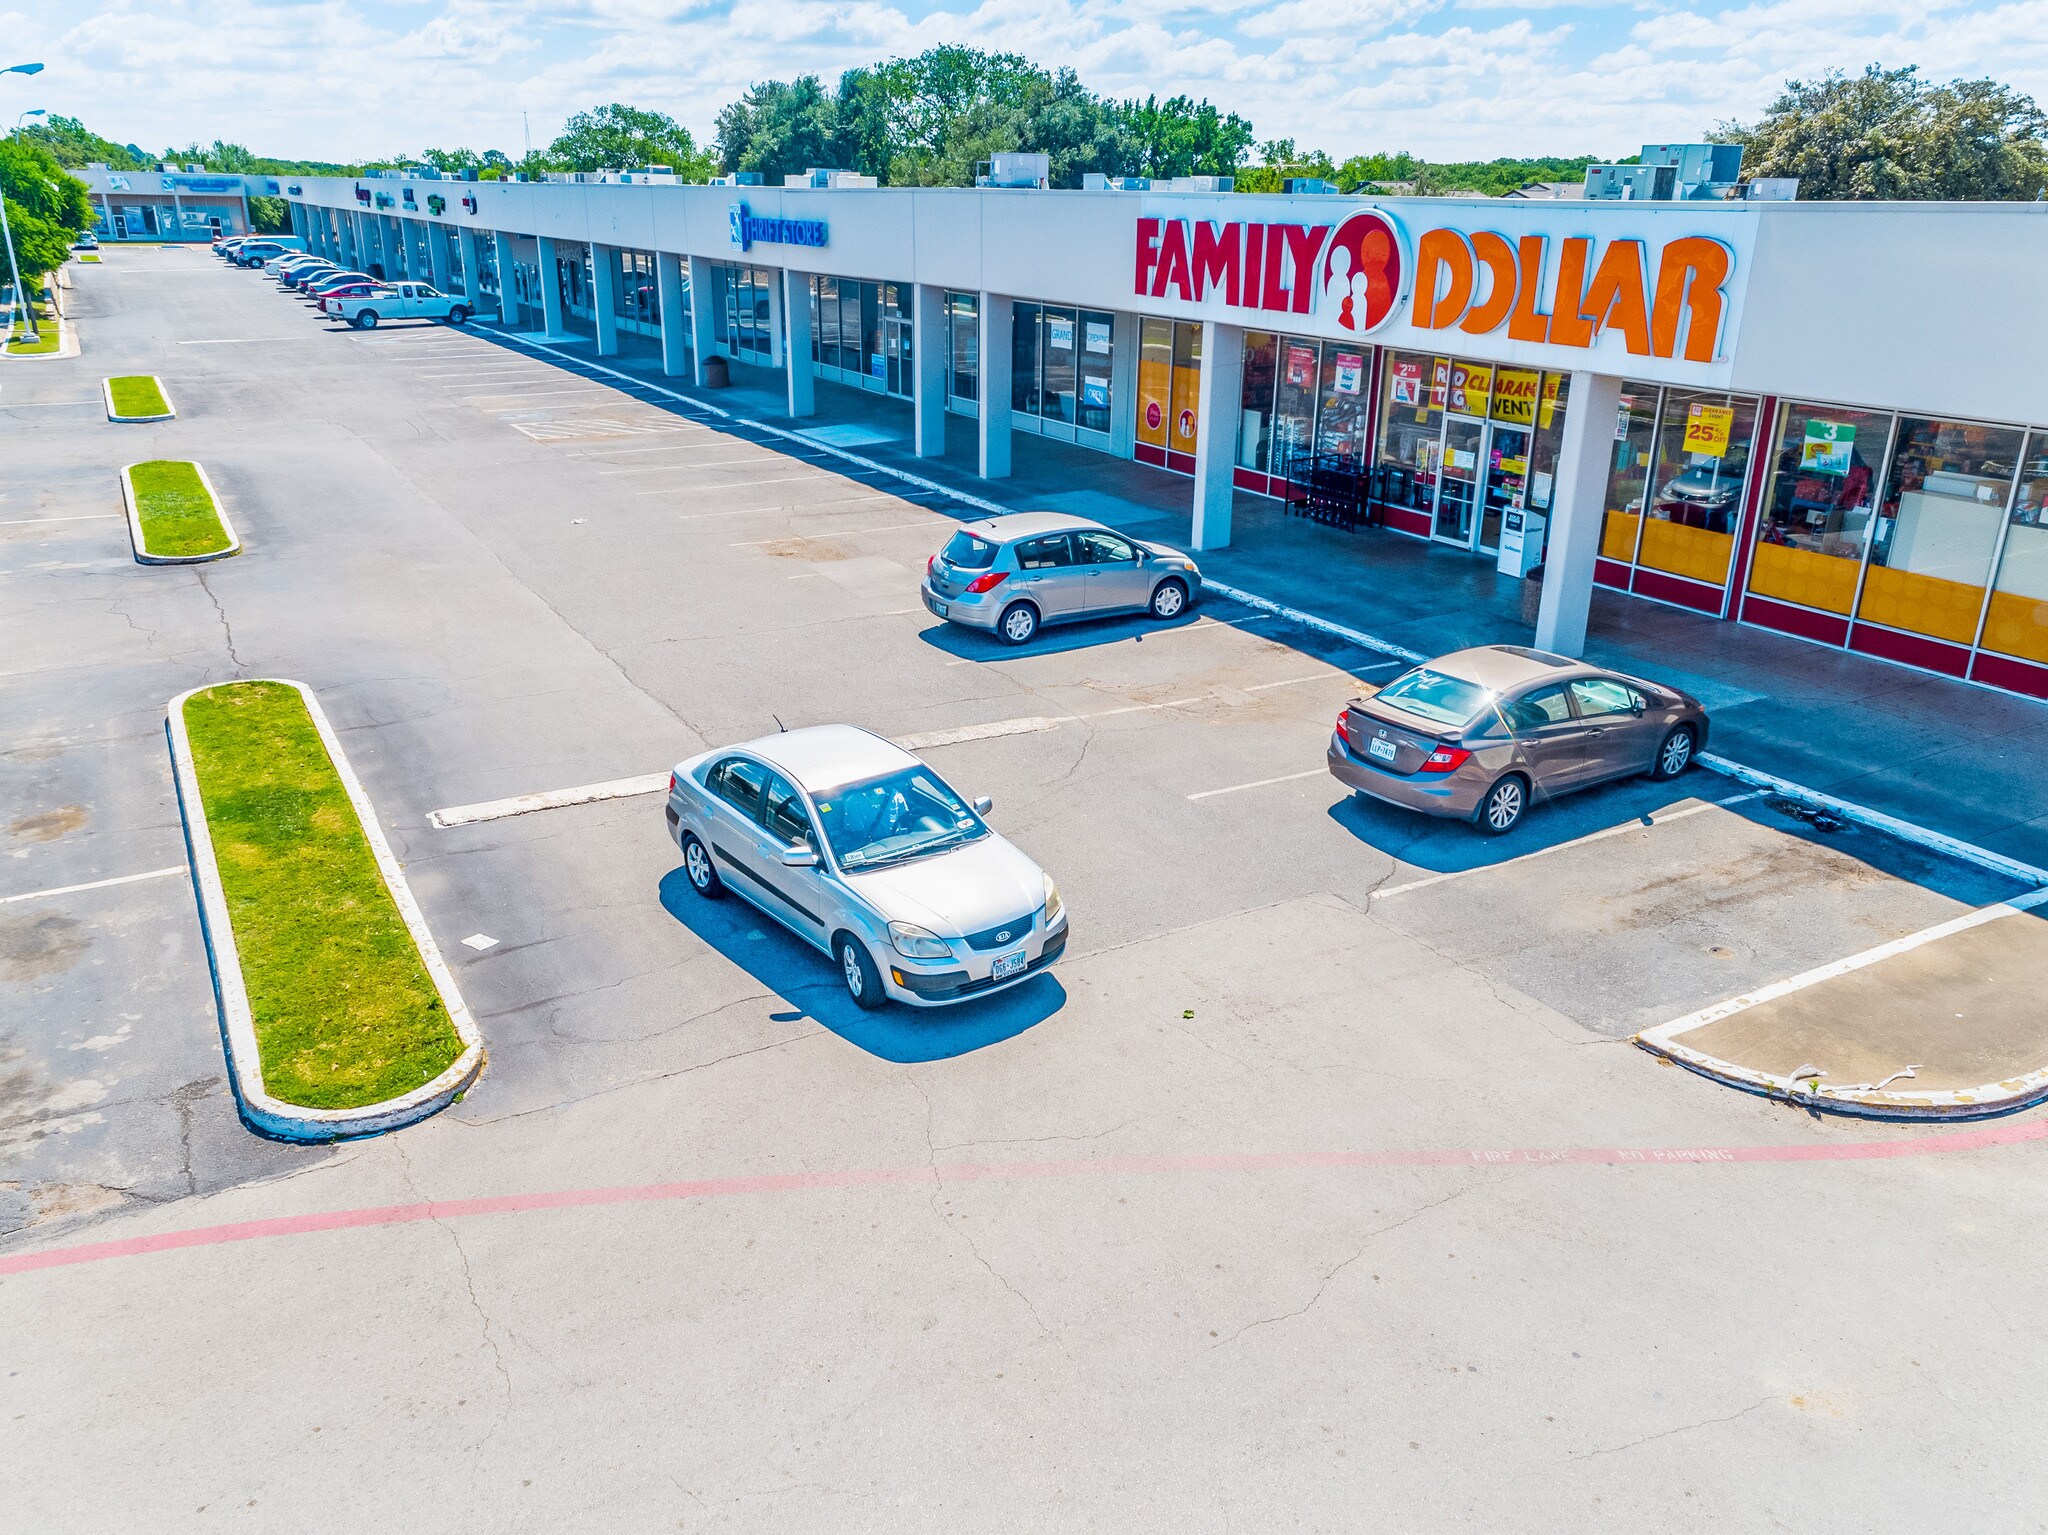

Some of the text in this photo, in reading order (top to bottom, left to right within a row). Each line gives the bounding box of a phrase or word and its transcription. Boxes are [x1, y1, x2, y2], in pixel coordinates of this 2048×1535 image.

[743, 218, 821, 247] THRIFT STORE
[1135, 217, 1734, 363] FAMILY DOLLAR
[1052, 328, 1072, 341] GRAND
[1436, 366, 1466, 387] RD
[1087, 387, 1104, 401] OPEN
[1436, 385, 1465, 406] TG
[997, 932, 1010, 941] KIA
